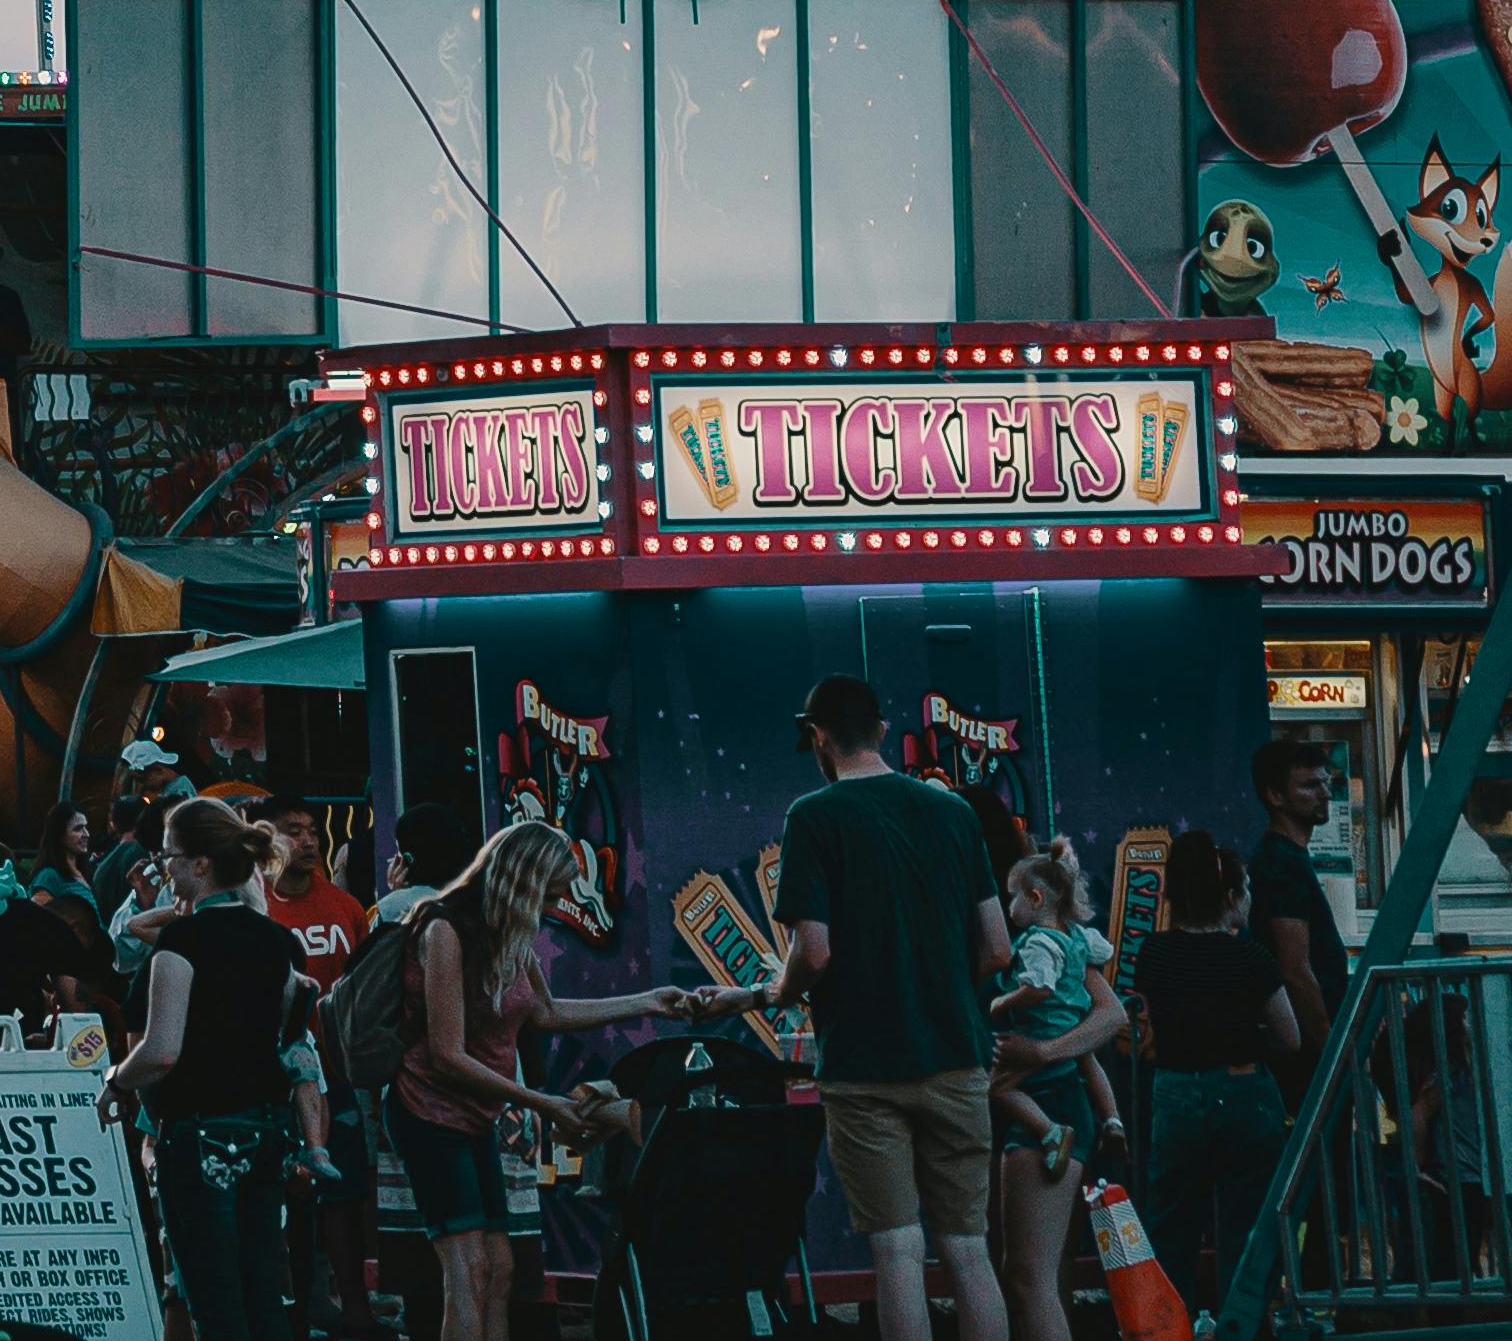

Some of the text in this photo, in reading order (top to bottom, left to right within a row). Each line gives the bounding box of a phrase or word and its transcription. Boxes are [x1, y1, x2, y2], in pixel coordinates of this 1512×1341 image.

[17, 94, 66, 112] JUM
[401, 401, 589, 521] TICKETS
[738, 394, 1126, 508] TICKETS
[1317, 512, 1407, 539] JUMBO
[1371, 542, 1472, 584] DOGS
[1298, 680, 1345, 703] CORN
[522, 684, 600, 757] BUTLER
[930, 696, 1009, 750] BUTLER
[77, 1030, 104, 1058] $15
[41, 1093, 56, 1108] IN
[60, 1092, 97, 1108] LINE?
[1, 1201, 117, 1225] AVAILABLE
[23, 1250, 41, 1267] AT
[48, 1250, 78, 1267] ANY
[84, 1249, 120, 1266] INFO
[10, 1270, 33, 1288] OR
[38, 1270, 69, 1287] BOX
[75, 1269, 130, 1286] OFFICE
[48, 1292, 100, 1307] ACCESS
[103, 1291, 122, 1306] TO
[76, 1307, 124, 1322] SHOWS
[52, 1323, 107, 1338] TIONS!
